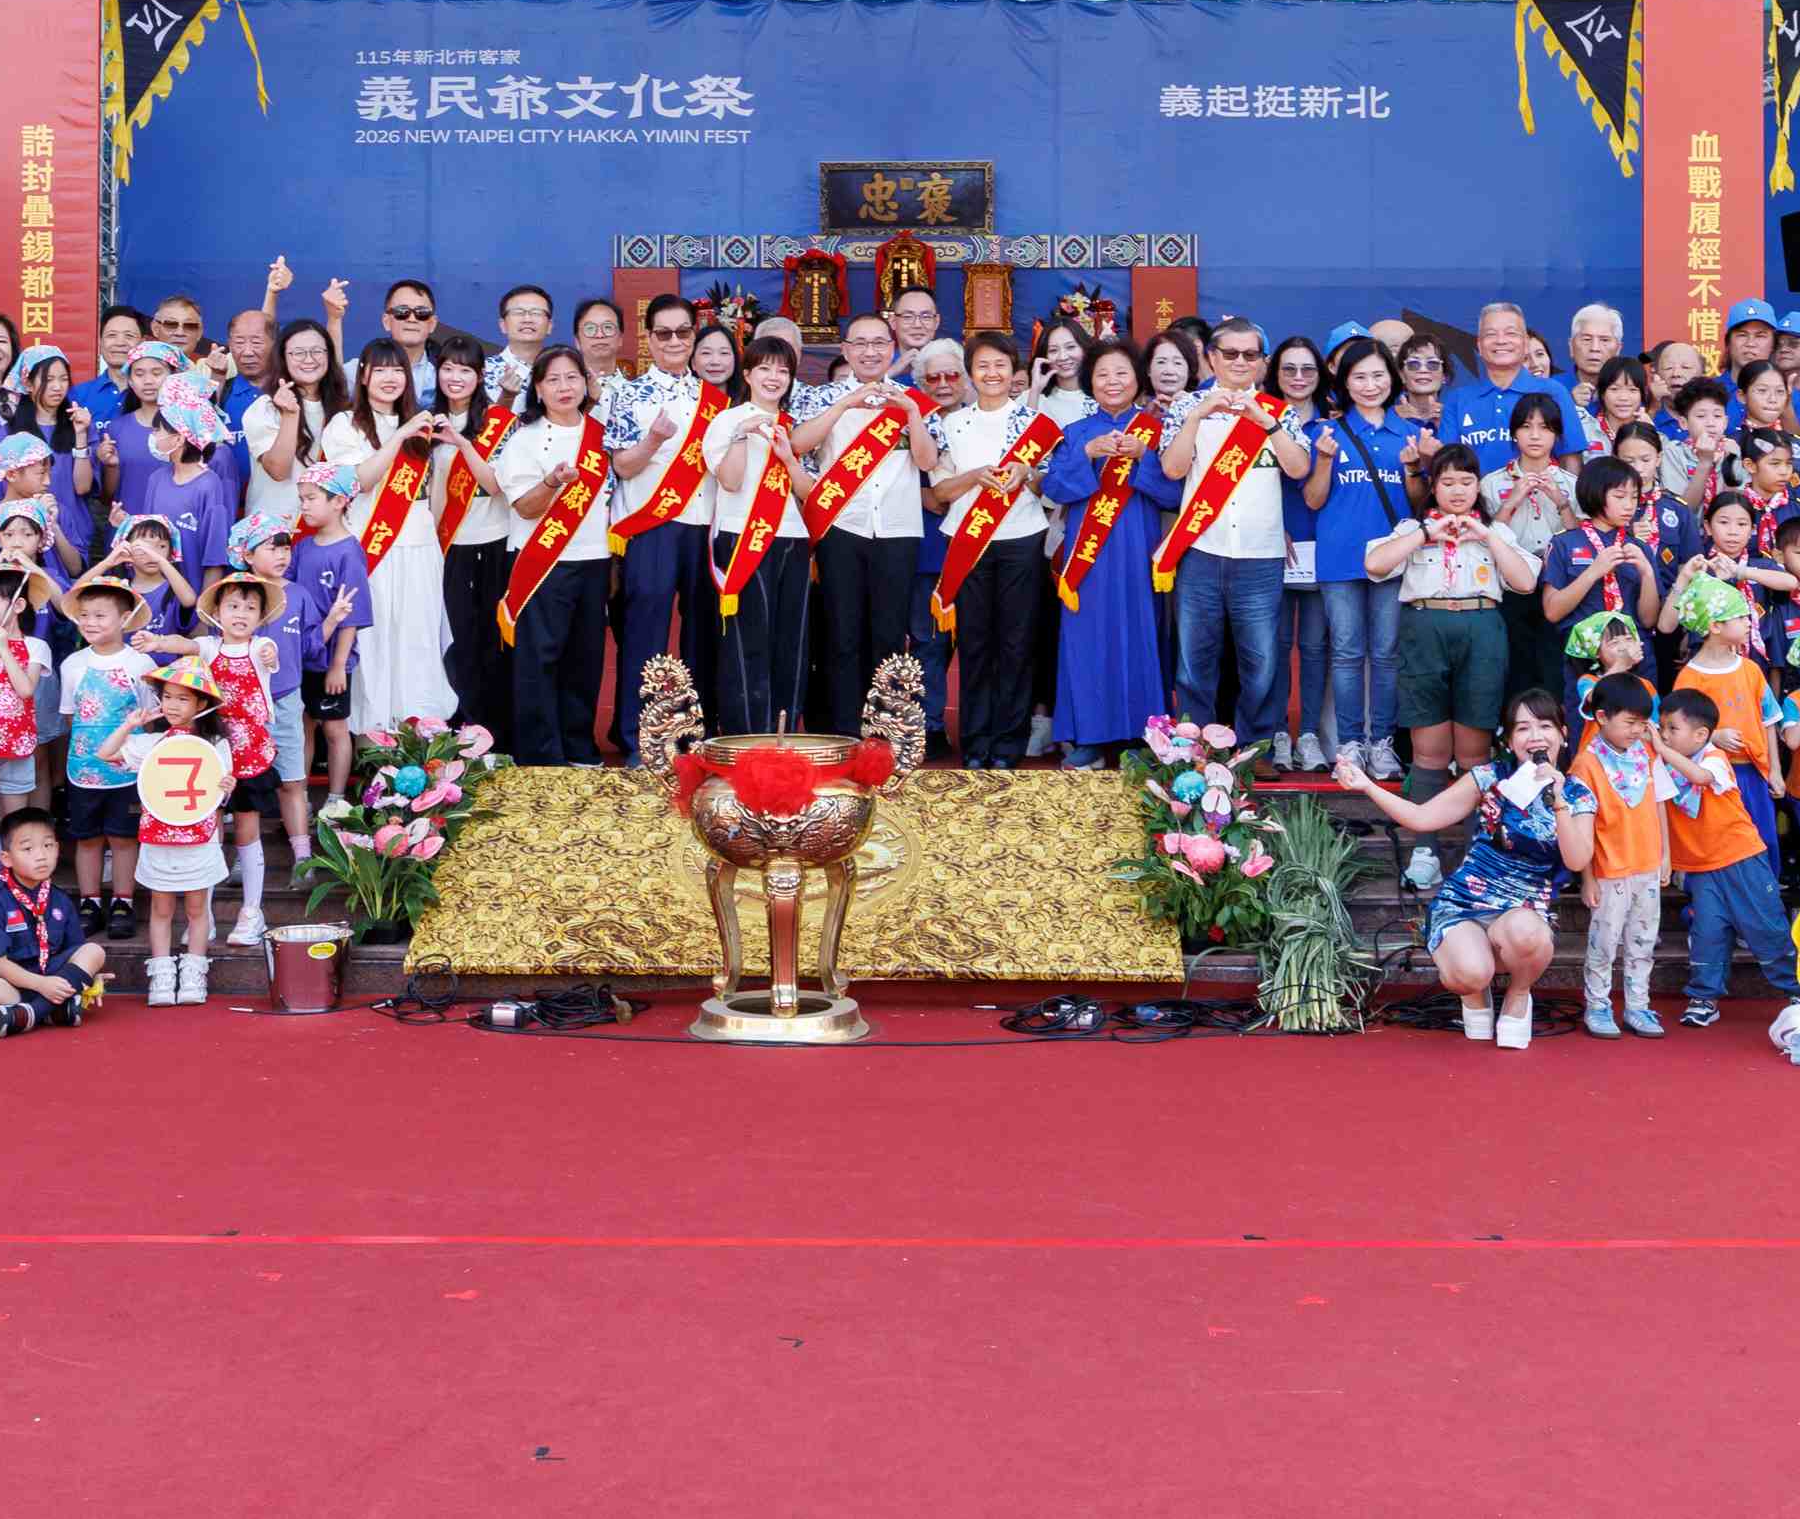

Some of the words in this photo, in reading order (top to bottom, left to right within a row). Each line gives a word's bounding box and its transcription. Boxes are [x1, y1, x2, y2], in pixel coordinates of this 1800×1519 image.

[355, 49, 521, 66] 115年新北市客家
[356, 73, 755, 121] 義民爺文化祭
[1159, 84, 1391, 119] 義起挺新北
[355, 128, 400, 145] 2026
[404, 128, 450, 145] NEW
[455, 128, 514, 145] TAIPEI
[518, 128, 564, 145] CITY
[568, 128, 638, 145] HAKKA
[642, 128, 699, 145] YIMIN
[703, 128, 751, 145] FEST
[21, 124, 54, 348] 誥封疊錫都因
[1461, 429, 1495, 445] NTPC
[817, 418, 900, 510] 正獻官
[538, 450, 602, 549] 正獻官
[158, 758, 207, 811] 子
